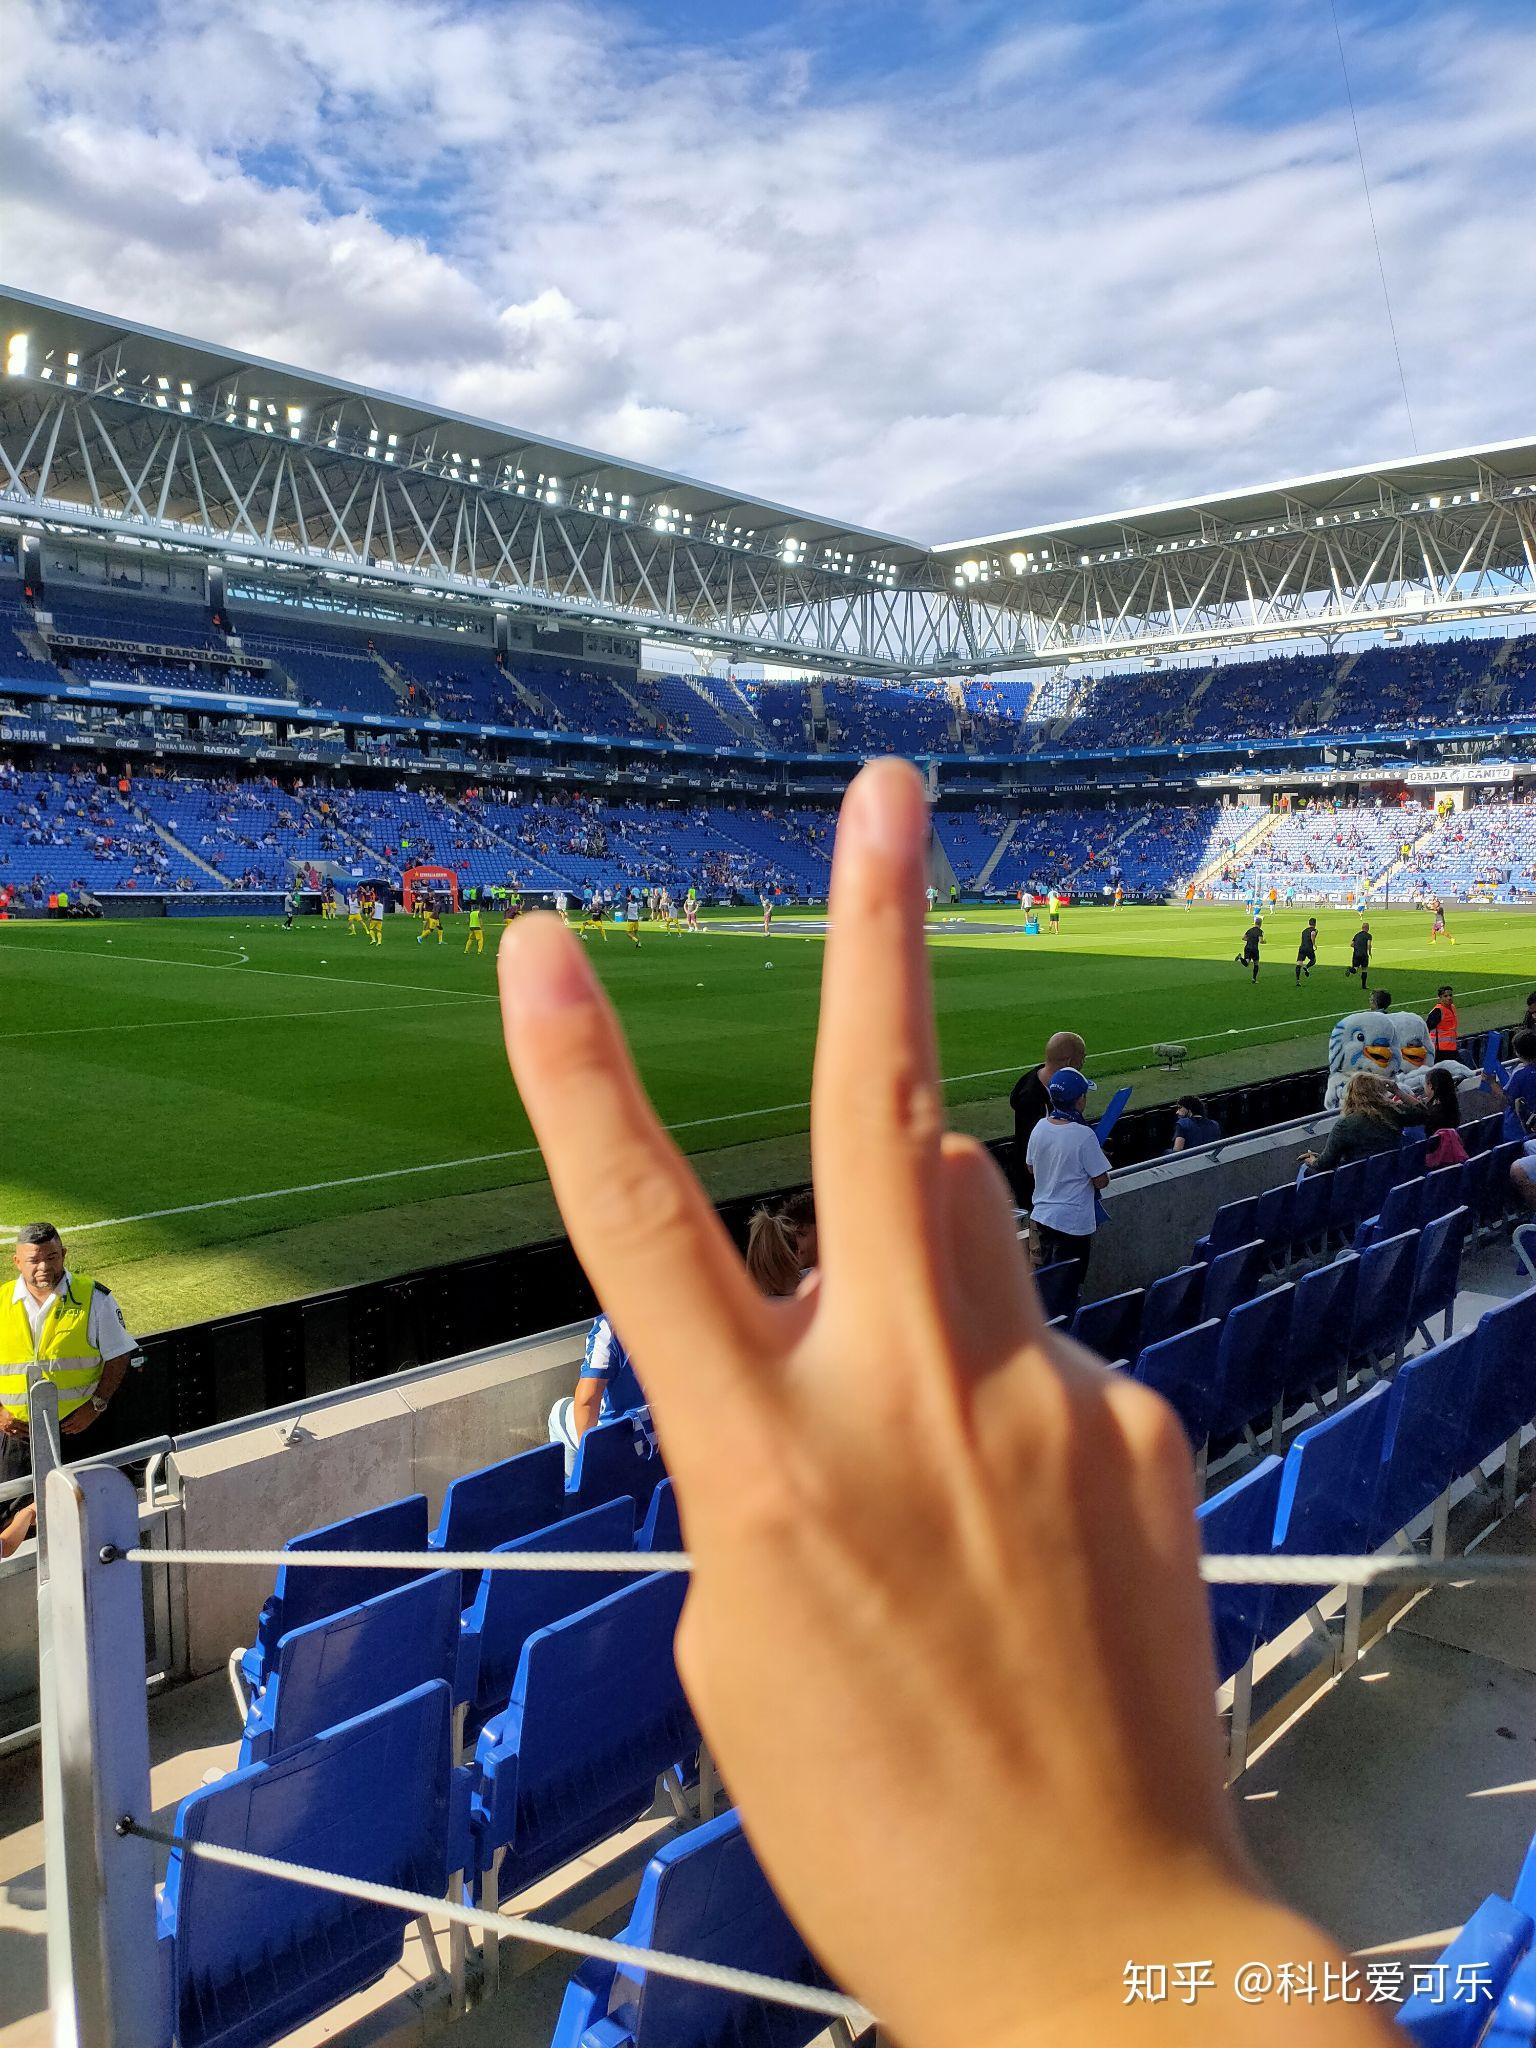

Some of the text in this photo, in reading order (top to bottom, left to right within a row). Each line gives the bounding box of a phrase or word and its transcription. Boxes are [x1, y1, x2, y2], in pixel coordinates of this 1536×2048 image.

[47, 634, 263, 667] RCD ESPANYOL DE BARCELONA 1900
[66, 735, 94, 744] bet365
[155, 742, 196, 751] RIVIERA MAYA
[203, 745, 240, 755] RASTAR
[1301, 774, 1336, 782] KELME
[1353, 771, 1390, 779] KELME
[1410, 768, 1510, 781] GRADA CANITO
